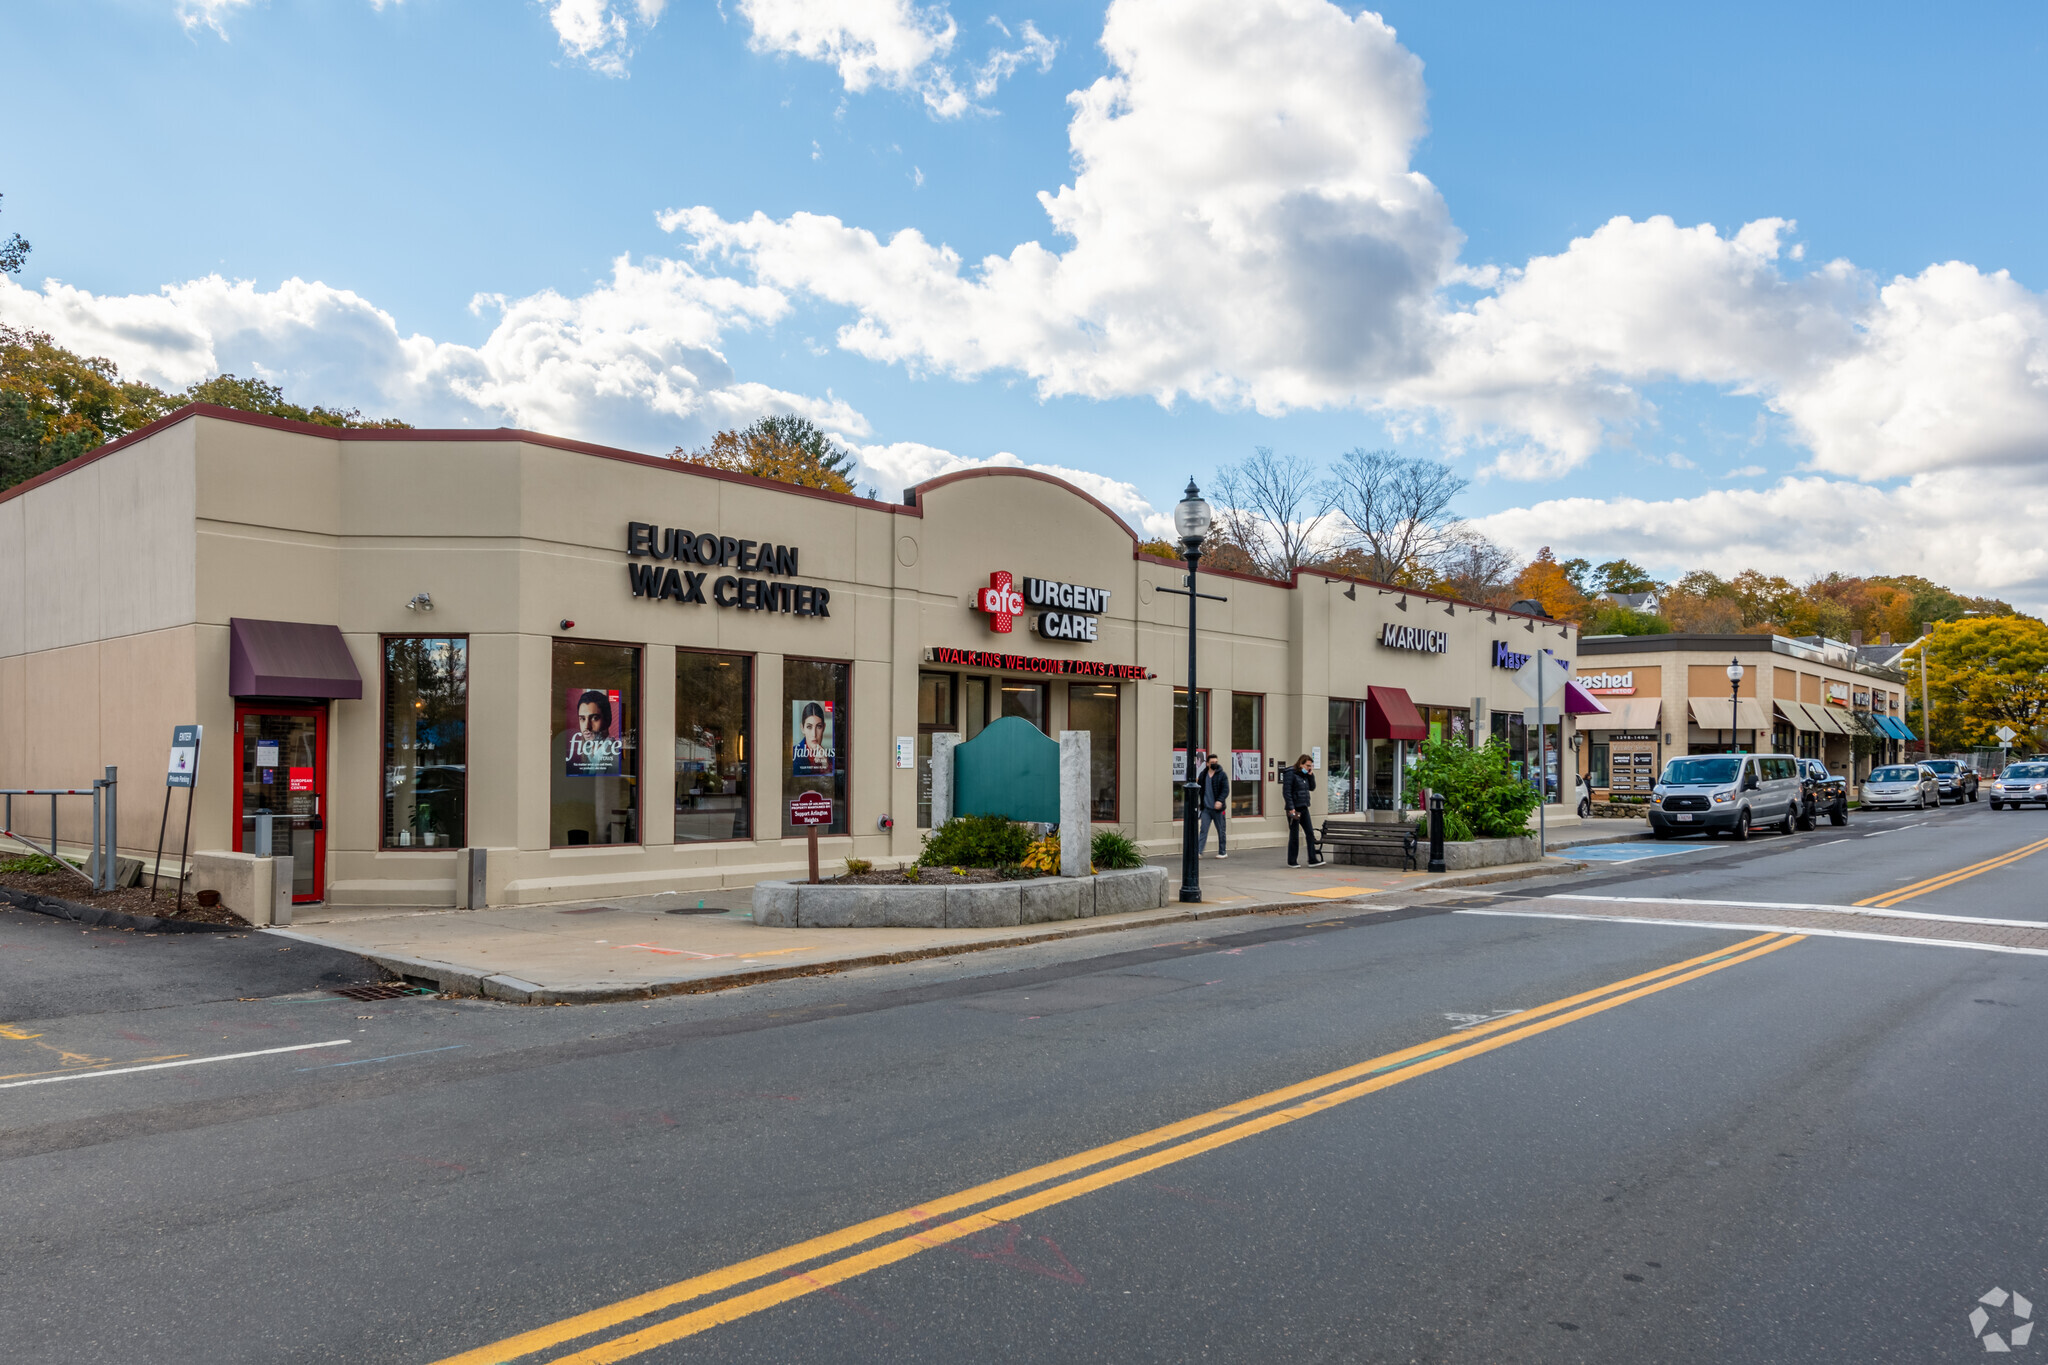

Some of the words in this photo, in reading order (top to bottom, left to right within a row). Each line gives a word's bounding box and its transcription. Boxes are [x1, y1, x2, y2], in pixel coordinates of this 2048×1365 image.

[628, 521, 799, 577] EUROPEAN
[628, 562, 708, 605] WAX
[713, 575, 831, 618] CENTER
[985, 582, 1022, 615] afc
[1030, 578, 1112, 613] URGENT
[1045, 612, 1099, 641] CARE
[1383, 622, 1449, 655] MARUICHI
[938, 647, 1002, 669] WALK-INS
[1005, 654, 1065, 675] WELCOME
[1066, 660, 1074, 674] 7
[1076, 660, 1106, 677] DAYS
[1107, 663, 1116, 678] A
[1117, 665, 1148, 680] WEEK
[1576, 670, 1633, 689] eashed
[178, 732, 192, 741] ENTER
[566, 733, 622, 761] fierce
[793, 744, 835, 760] fabulous
